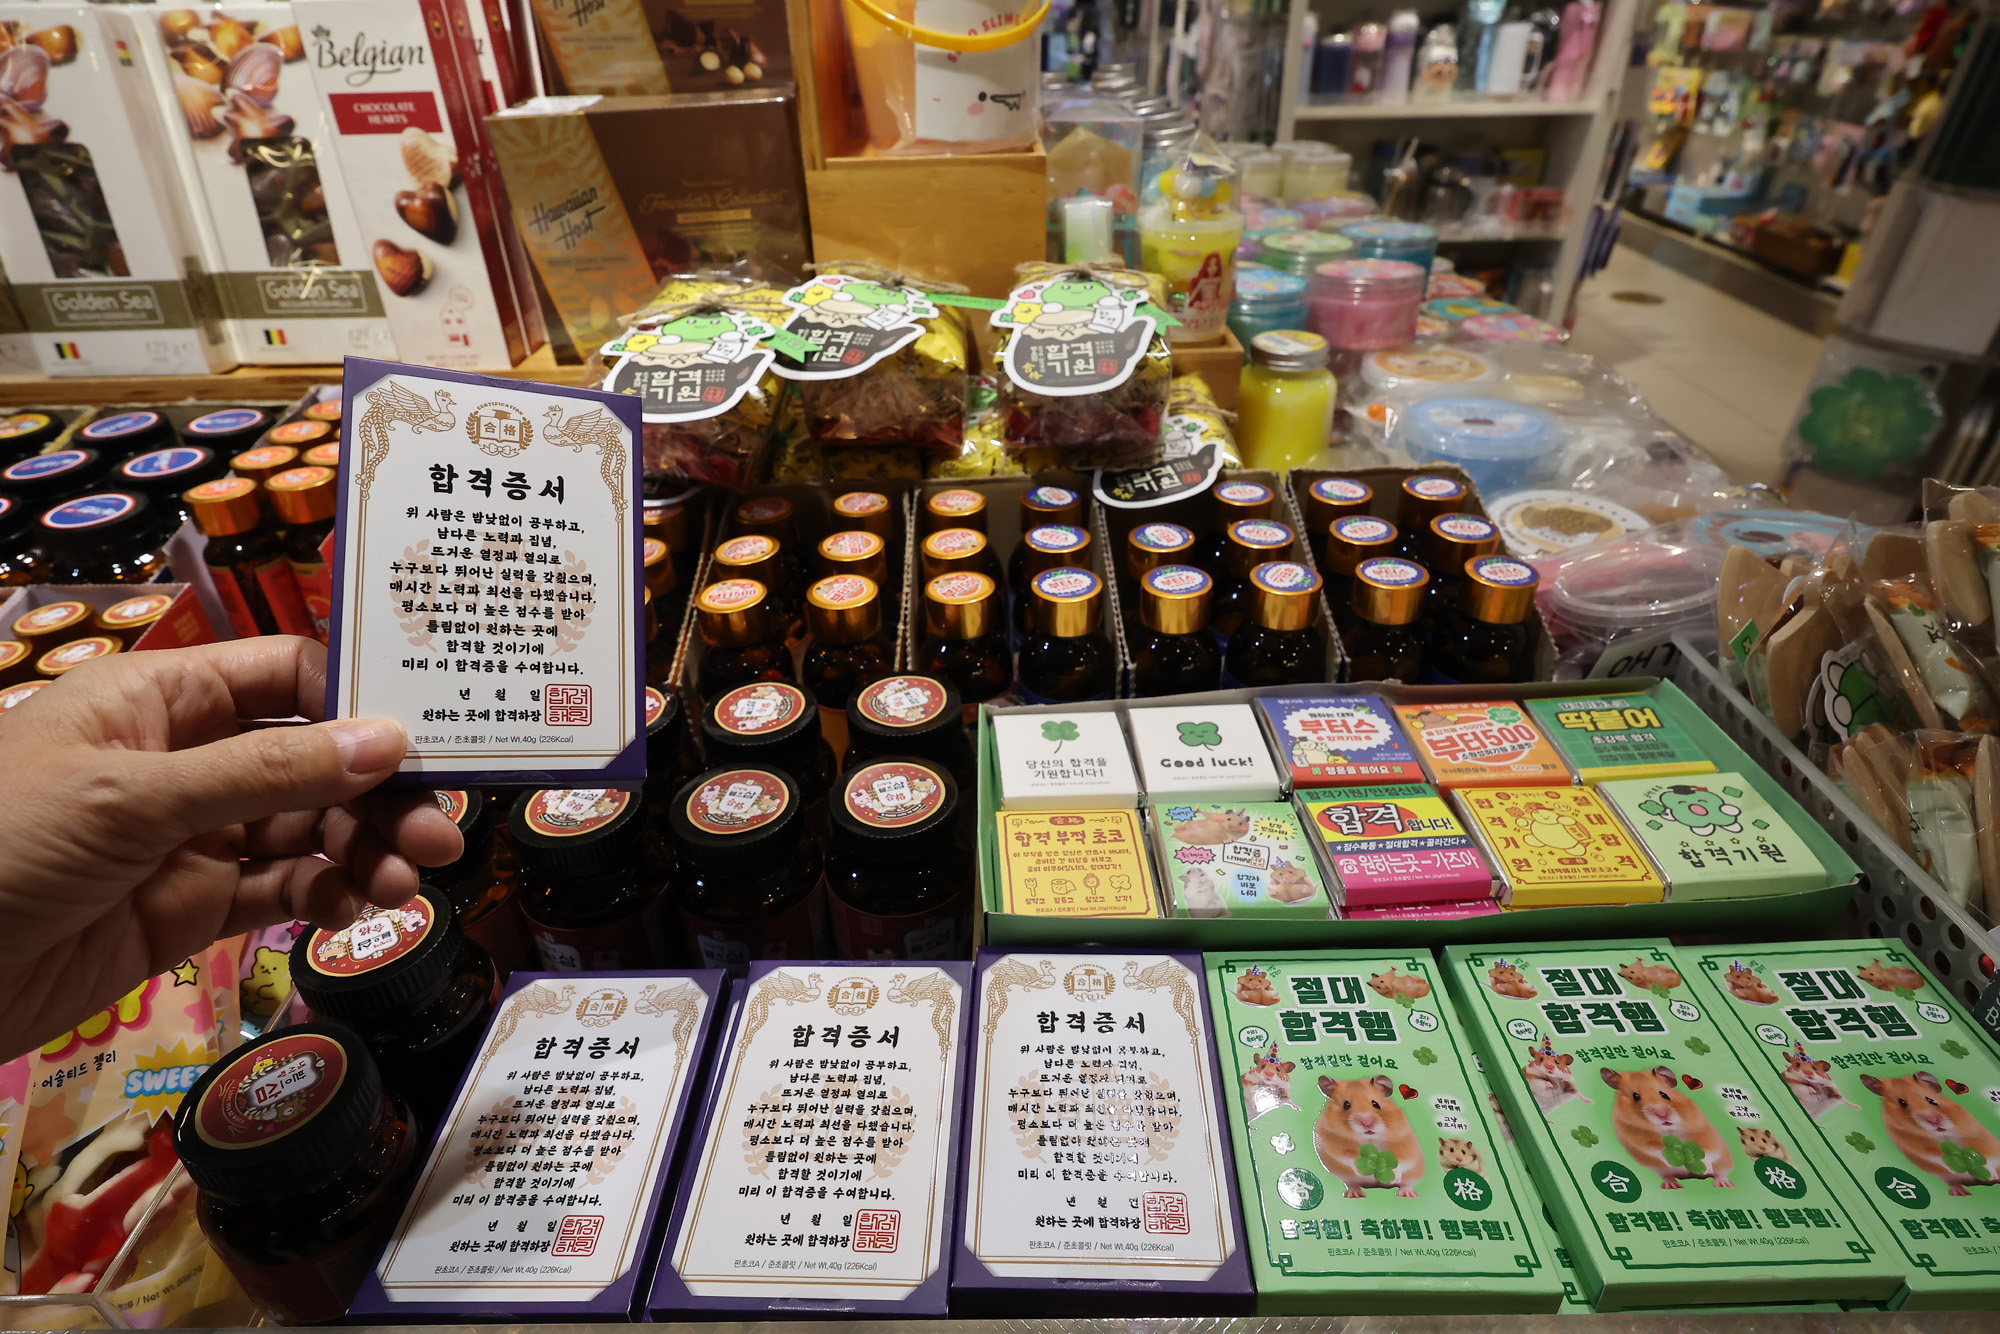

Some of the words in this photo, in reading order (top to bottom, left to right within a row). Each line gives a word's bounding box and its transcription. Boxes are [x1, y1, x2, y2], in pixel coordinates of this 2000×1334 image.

[312, 32, 424, 87] Belgian
[353, 102, 416, 113] CHOCOLATE
[367, 114, 409, 124] HEARTS
[528, 186, 599, 235] Hawaiian
[555, 206, 606, 250] Host
[328, 279, 359, 298] Sea
[52, 288, 119, 312] Golden
[119, 290, 155, 310] Sea
[1046, 341, 1094, 359] 합격
[1047, 357, 1096, 377] 기원
[651, 369, 703, 386] 합격
[650, 384, 702, 404] 기원
[477, 401, 523, 415] CERTIFICATION
[429, 464, 564, 504] 합격증서
[406, 506, 418, 518] 위
[426, 508, 465, 522] 사람은
[473, 512, 522, 527] 밤낮없이
[529, 517, 584, 534] 공부하고,
[438, 527, 477, 541] 남다른
[483, 532, 523, 545] 노력과
[529, 535, 556, 549] 집념,
[431, 546, 473, 559] 뜨거운
[480, 549, 518, 562] 열정과
[524, 552, 561, 564] 열의로
[390, 562, 448, 576] 누구보다
[455, 565, 494, 579] 뛰어난
[500, 568, 536, 582] 실력을
[544, 571, 596, 587] 갖췄으며,
[390, 580, 432, 594] 매시간
[438, 584, 480, 596] 노력과
[486, 585, 523, 599] 최선을
[530, 588, 596, 603] 다했습니다.
[402, 600, 458, 614] 평소보다
[466, 603, 476, 615] 더
[484, 604, 509, 616] 높은
[516, 605, 554, 619] 점수를
[561, 608, 585, 620] 받아
[487, 623, 526, 636] 원하는
[532, 625, 557, 637] 곳에
[446, 640, 485, 653] 합격할
[493, 642, 543, 655] 것이기에
[403, 658, 428, 671] 미리
[436, 659, 447, 671] 이
[456, 659, 508, 673] 합격증을
[515, 661, 583, 675] 수여합니다.
[460, 688, 470, 700] 년
[495, 688, 506, 701] 월
[530, 689, 540, 701] 일
[423, 709, 460, 721] 원하는
[465, 709, 490, 721] 곳에
[495, 709, 541, 722] 합격하장
[1556, 708, 1662, 732] 딱붙어
[1299, 719, 1379, 734] 부터스
[415, 736, 445, 744] 판초코A
[511, 736, 536, 744] Wt.40g
[539, 735, 573, 743] (226Kcal)
[1426, 725, 1536, 761] 부터500
[1026, 760, 1064, 770] 당신의
[1070, 758, 1107, 768] 합격을
[1160, 758, 1204, 768] Good
[1211, 756, 1254, 767] luck!
[1325, 766, 1357, 775] 행운을
[1359, 765, 1390, 775] 빌어요
[1034, 768, 1104, 779] 기원합니다!
[886, 793, 907, 802] 合格
[1325, 803, 1404, 835] 합격
[1406, 818, 1454, 832] 합니다!
[1015, 831, 1051, 847] 합격
[1057, 830, 1086, 845] 부적
[1093, 829, 1125, 845] 초코
[1678, 843, 1787, 868] 합격기원
[1291, 976, 1366, 1005] 절대
[1542, 968, 1624, 997] 절대
[1779, 971, 1867, 1002] 절대
[1037, 1011, 1145, 1034] 합격증서
[1279, 1009, 1398, 1042] 합격햄
[1542, 1002, 1666, 1033] 합격햄
[1785, 1005, 1918, 1041] 합격햄
[793, 1025, 899, 1048] 합격증서
[534, 1037, 639, 1059] 합격증서
[1575, 1047, 1628, 1063] 합격길만
[1631, 1047, 1676, 1061] 걸어요
[41, 1062, 88, 1088] 어솔티드
[93, 1050, 116, 1072] 젤리
[769, 1059, 779, 1068] 위
[784, 1059, 814, 1068] 사람은
[820, 1059, 860, 1069] 밤낮없이
[865, 1061, 911, 1071] 공부하고,
[1300, 1054, 1353, 1071] 합격길만
[1357, 1054, 1399, 1070] 걸어요
[1831, 1054, 1883, 1070] 합격길만
[1888, 1052, 1935, 1066] 걸어요
[507, 1071, 517, 1080] 위
[521, 1071, 550, 1080] 사람은
[556, 1071, 595, 1080] 밤낮없이
[600, 1071, 643, 1081] 공부하고,
[1601, 1171, 1630, 1194] 合
[1765, 1167, 1796, 1190] 格
[1886, 1177, 1920, 1200] 合
[1454, 1178, 1483, 1201] 格
[1036, 1215, 1067, 1227] 원하는
[1072, 1216, 1094, 1228] 곳에
[1099, 1217, 1141, 1229] 합격하장
[1360, 1219, 1433, 1240] 축하햄!
[1440, 1219, 1515, 1241] 행복햄!
[1605, 1211, 1681, 1233] 합격햄!
[1687, 1208, 1760, 1230] 축하햄!
[1761, 1207, 1841, 1229] 행복햄!
[1899, 1218, 1977, 1240] 합격햄!
[449, 1240, 481, 1252] 원하는
[484, 1240, 507, 1252] 곳에
[510, 1240, 550, 1252] 합격하장
[745, 1233, 777, 1245] 원하는
[782, 1234, 804, 1246] 곳에
[808, 1234, 850, 1247] 합격하장
